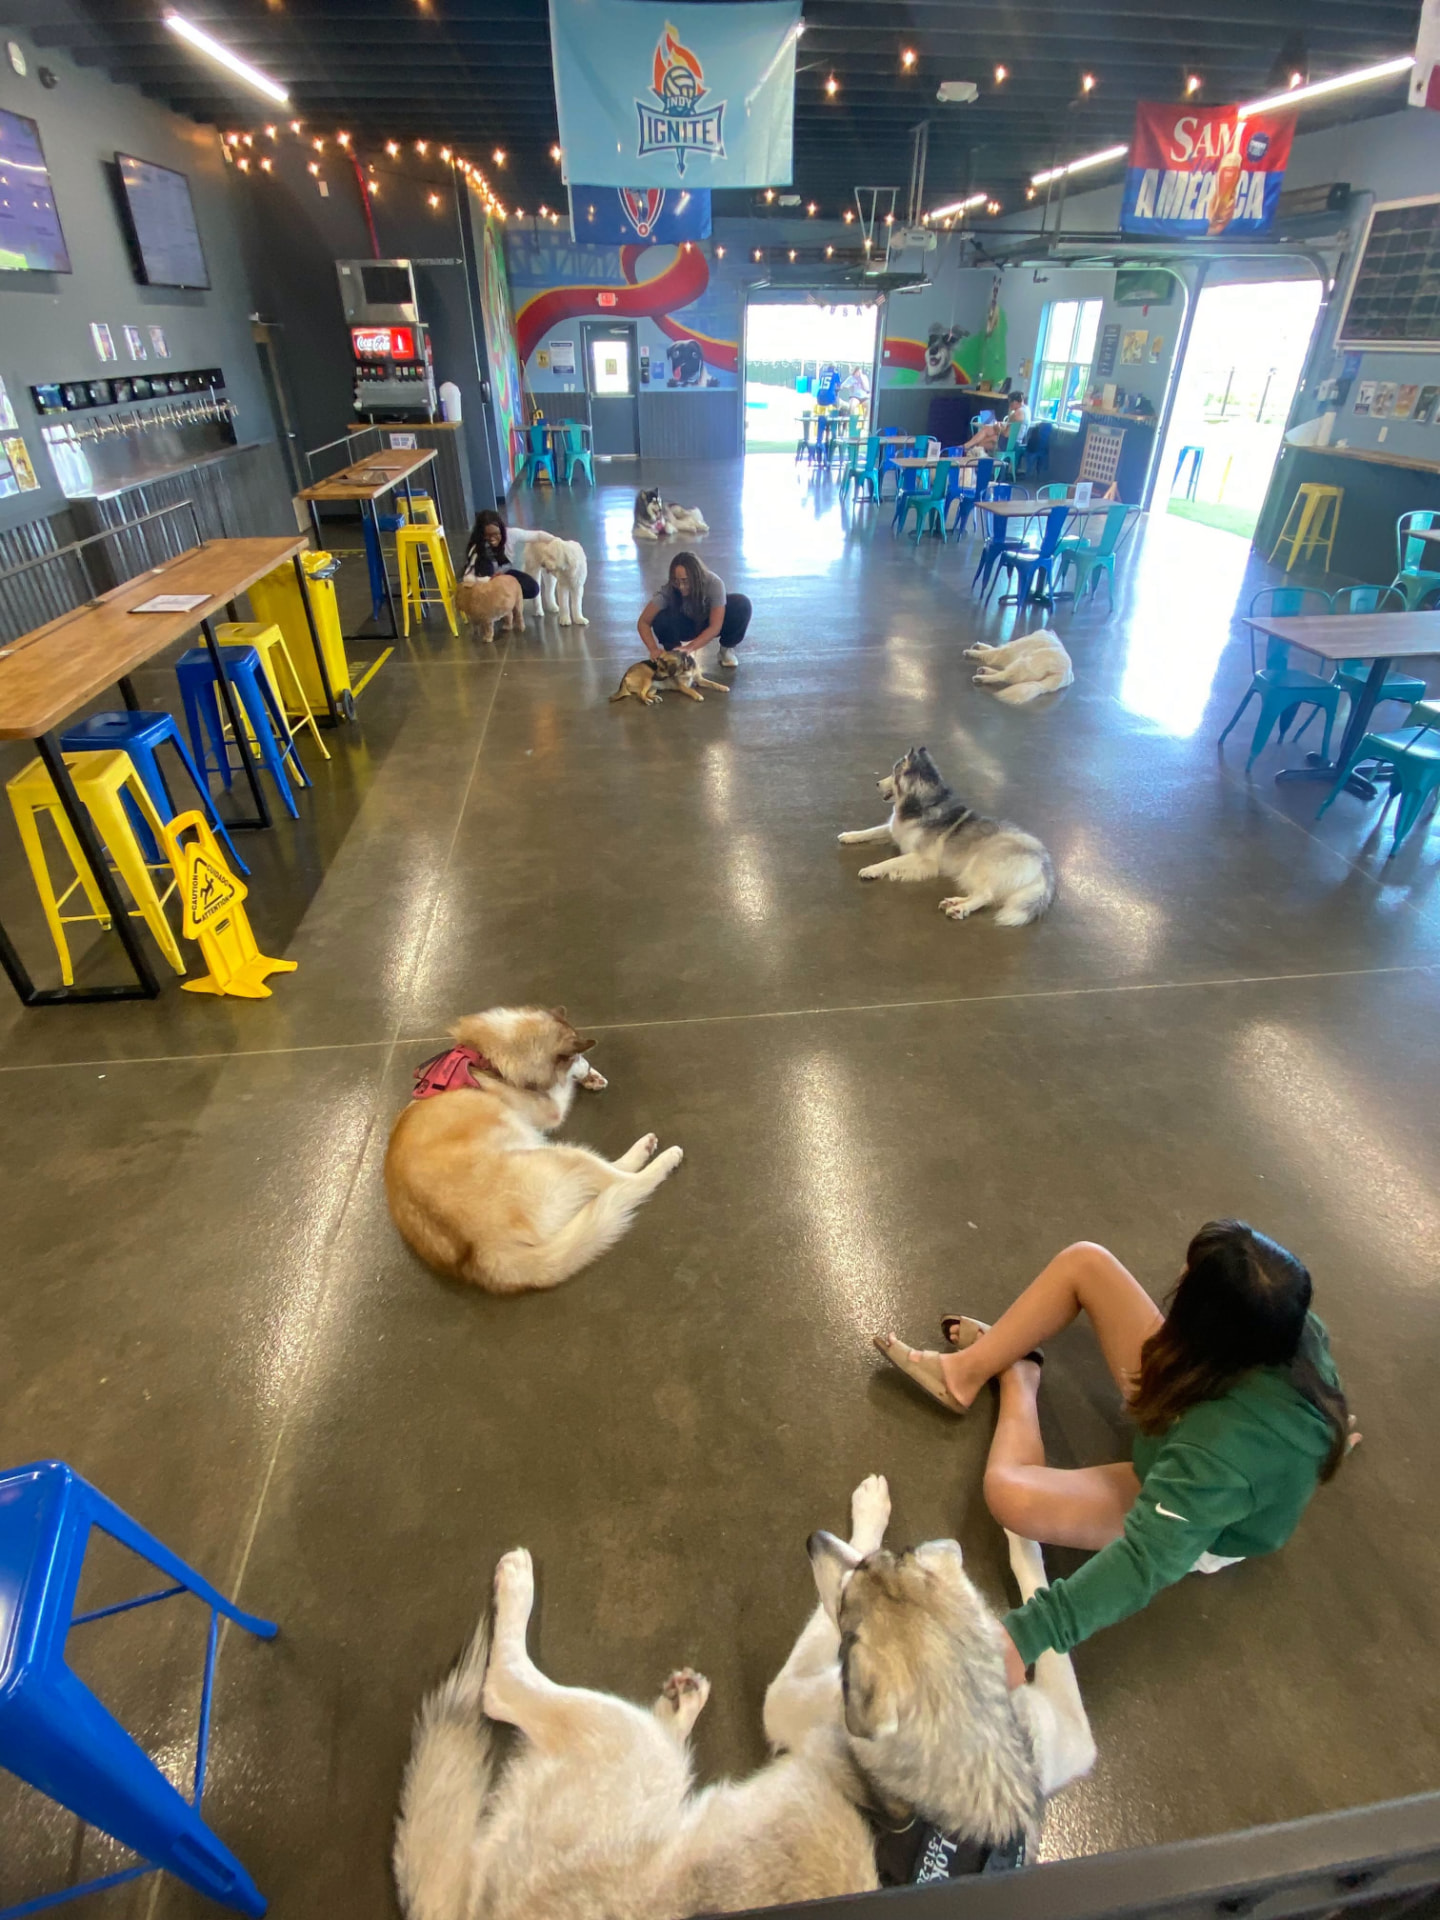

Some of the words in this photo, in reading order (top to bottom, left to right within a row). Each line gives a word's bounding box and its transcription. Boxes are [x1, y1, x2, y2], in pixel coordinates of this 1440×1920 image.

[667, 96, 692, 108] INDY
[648, 116, 714, 145] IGNITE
[1170, 117, 1247, 162] SAM
[1134, 168, 1266, 219] AMERCA
[207, 864, 229, 886] CUIDADO
[201, 896, 230, 921] ATTENTION
